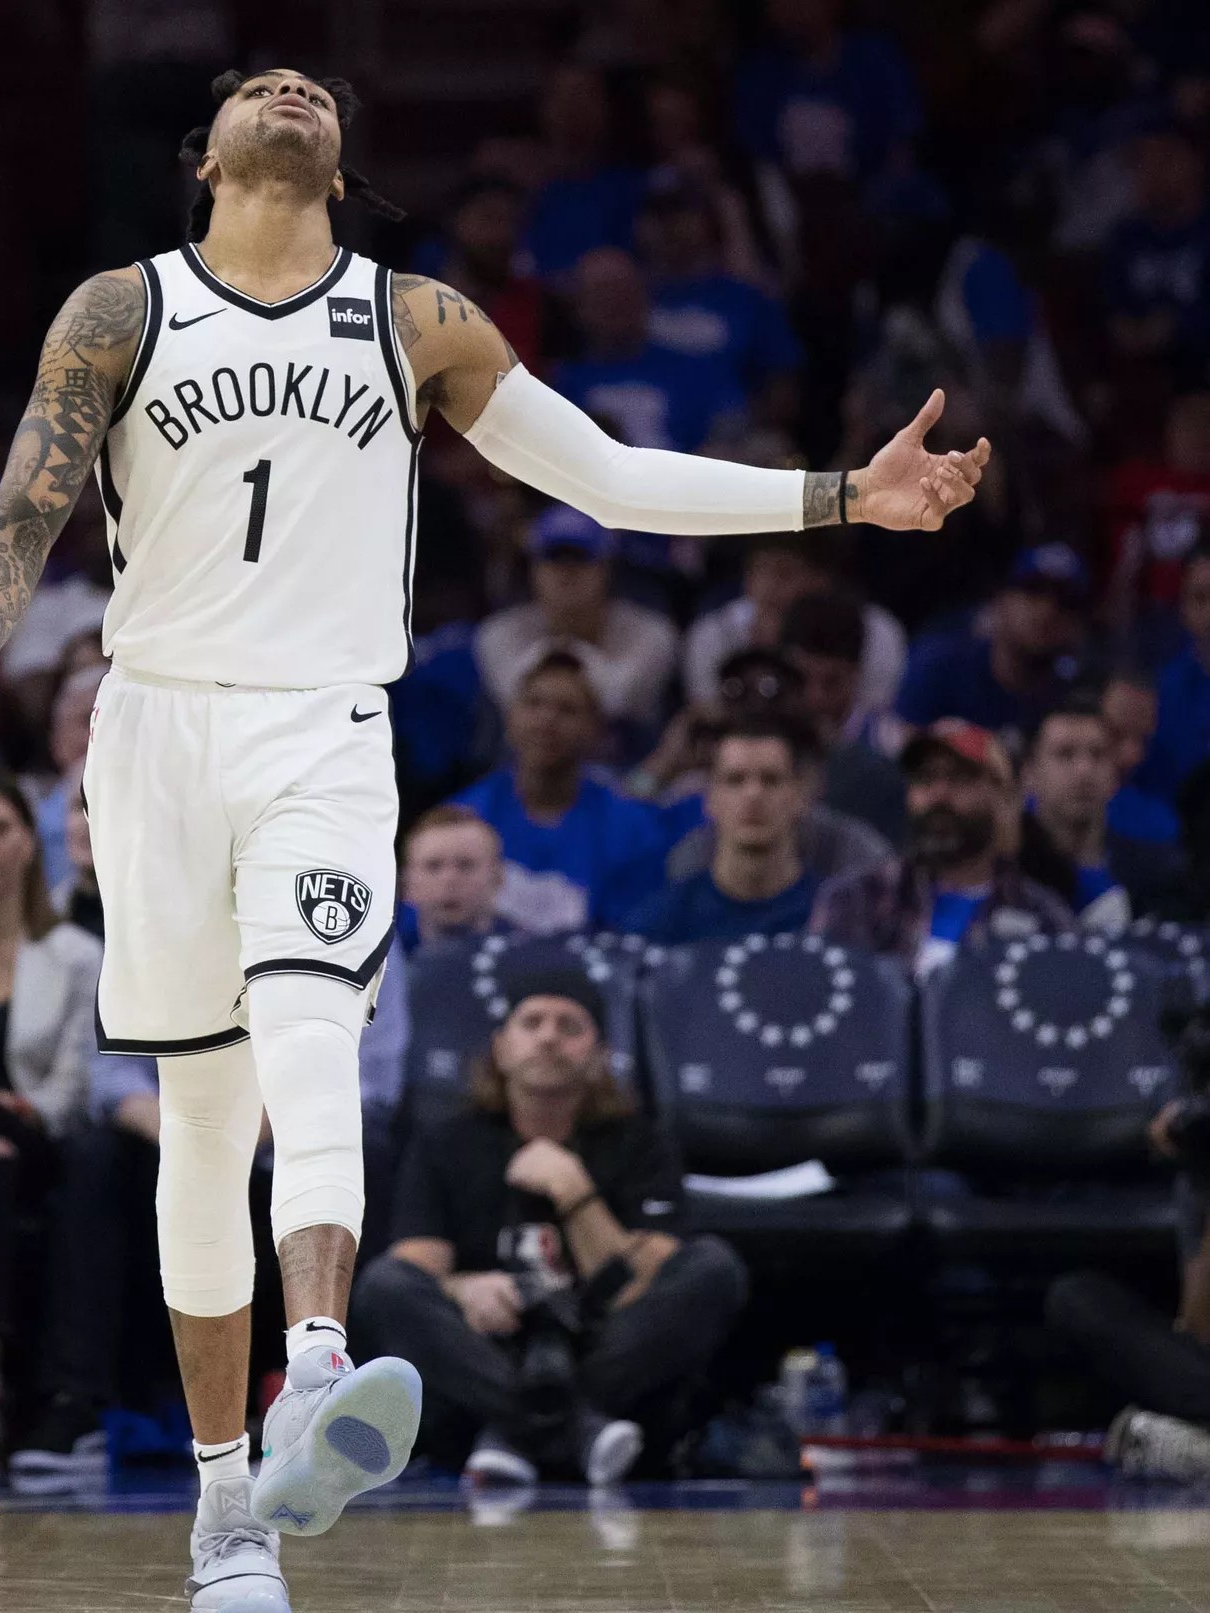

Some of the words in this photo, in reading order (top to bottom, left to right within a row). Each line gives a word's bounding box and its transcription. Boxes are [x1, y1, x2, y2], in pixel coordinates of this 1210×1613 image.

[331, 308, 371, 325] infor
[145, 362, 393, 450] BROOKLYN
[243, 459, 271, 563] 1
[301, 874, 367, 912] NETS
[325, 905, 338, 931] B
